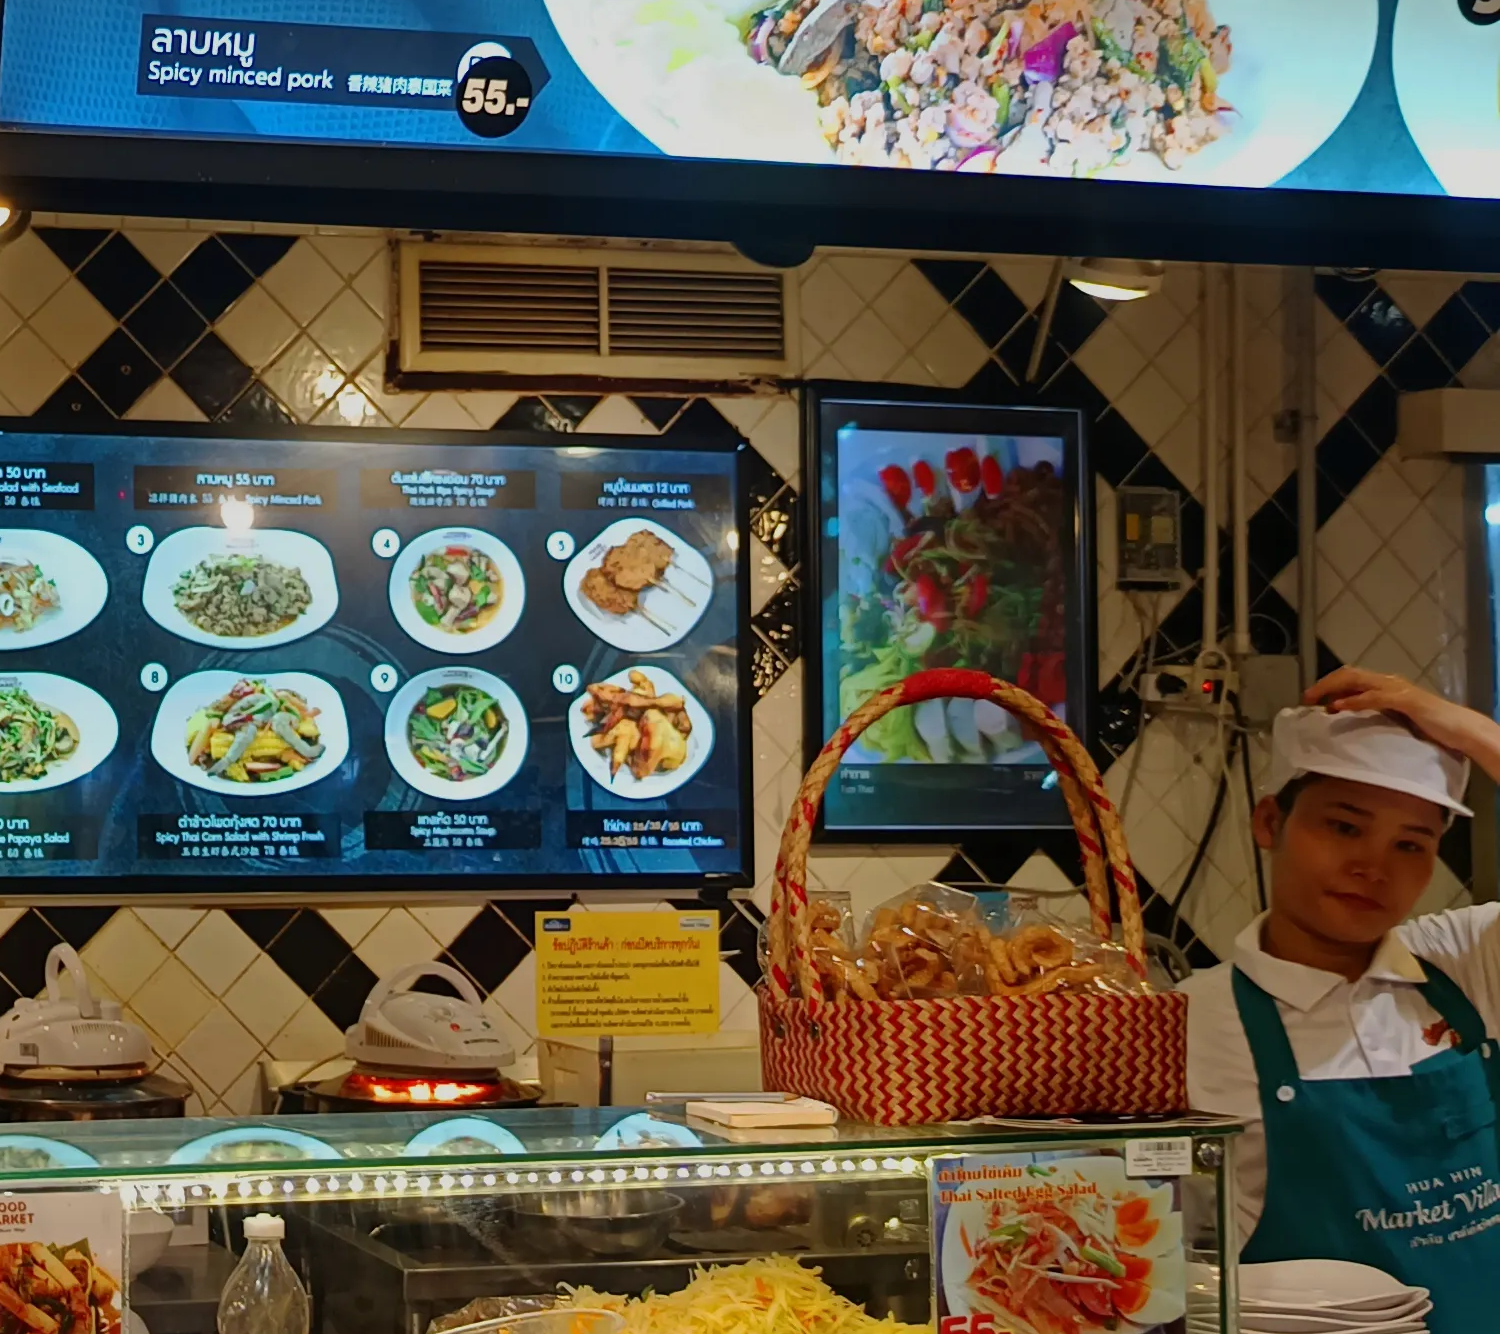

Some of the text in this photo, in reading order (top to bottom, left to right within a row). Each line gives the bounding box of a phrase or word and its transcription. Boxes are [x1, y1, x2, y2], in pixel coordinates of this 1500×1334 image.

[151, 26, 255, 67] ลาบหมู
[148, 60, 334, 92] Spicy minced pork
[462, 78, 530, 116] 55.-
[137, 534, 145, 546] 3
[383, 539, 390, 549] 4
[558, 541, 565, 551] 5
[151, 671, 159, 683] 8
[380, 672, 388, 684] 9
[558, 673, 573, 685] 10
[44, 832, 70, 844] Salad
[156, 831, 180, 844] Spicy
[251, 831, 270, 842] with
[1405, 1166, 1482, 1194] HUA HIN
[975, 1186, 1021, 1202] Salted
[1056, 1182, 1097, 1197] Salad
[1355, 1200, 1456, 1232] Market
